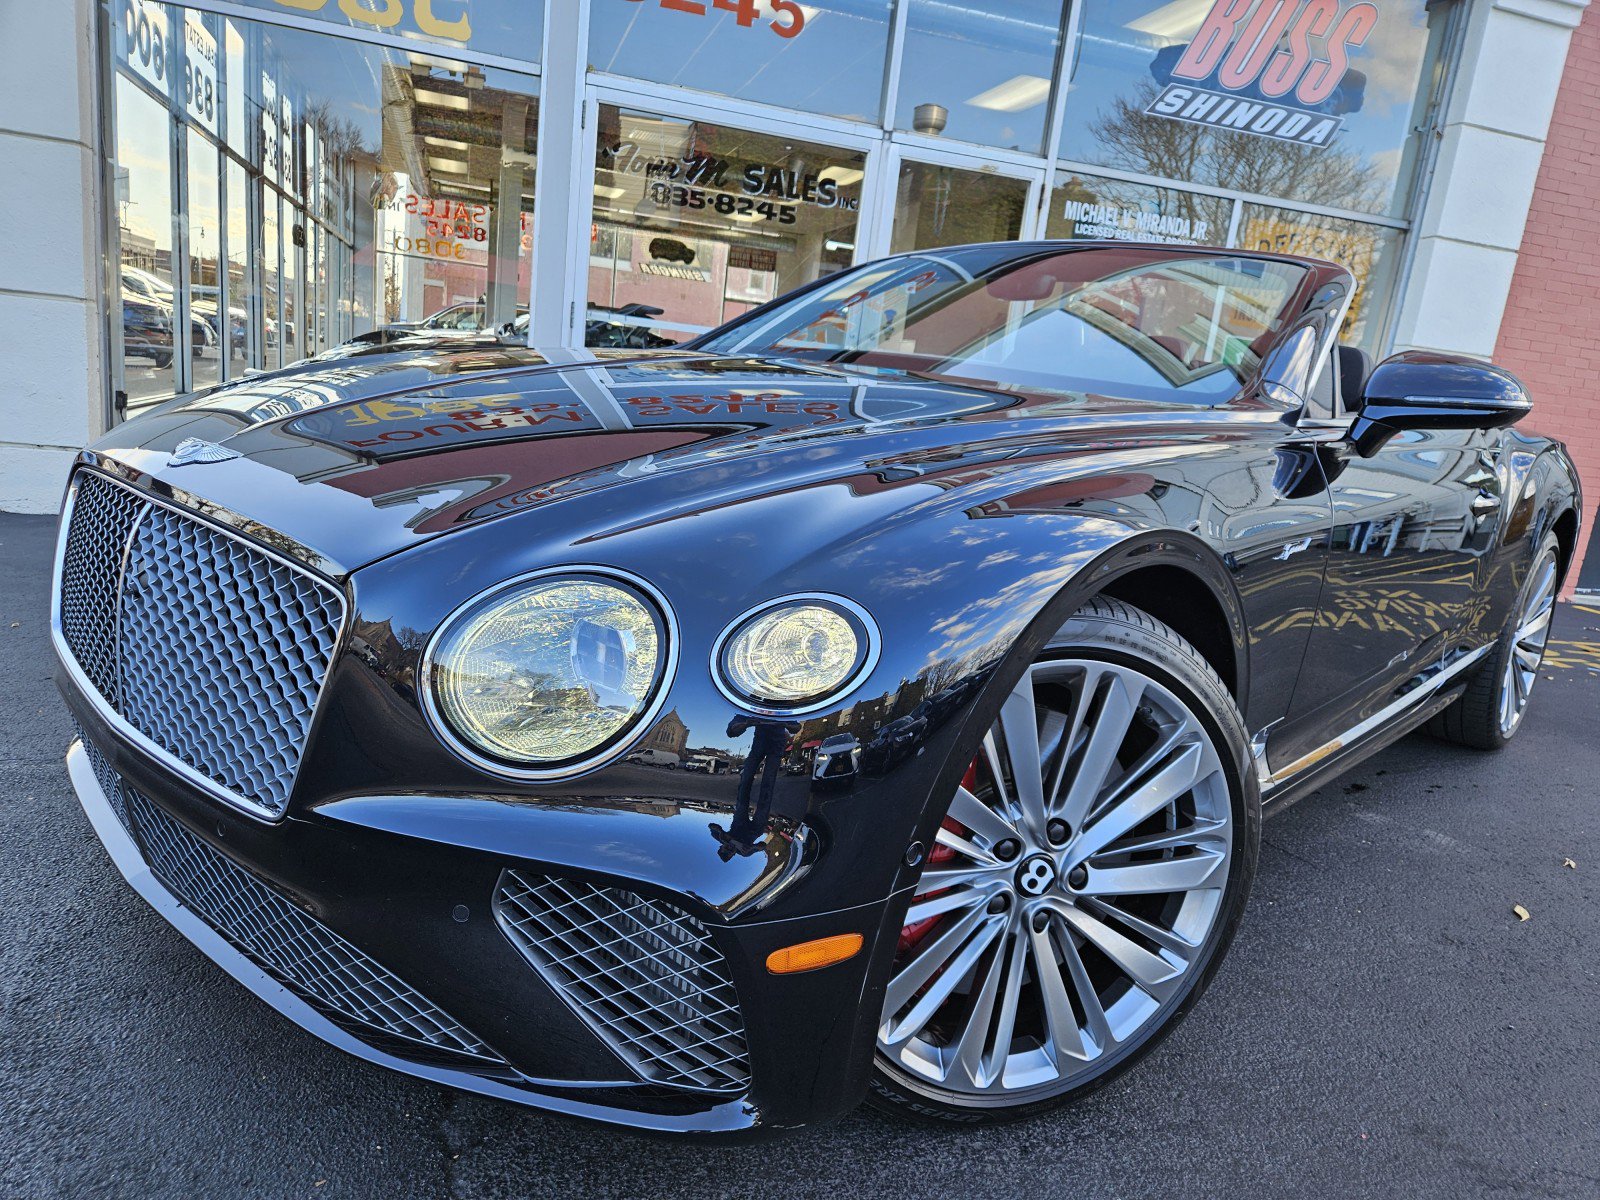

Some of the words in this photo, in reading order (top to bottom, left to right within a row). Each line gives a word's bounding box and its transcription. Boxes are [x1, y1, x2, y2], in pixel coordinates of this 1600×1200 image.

[1171, 0, 1379, 105] BOSS
[1154, 88, 1337, 144] SHINODA
[742, 162, 838, 208] SALES
[1064, 200, 1120, 227] MICHAEL
[1135, 211, 1192, 238] MIRANDA
